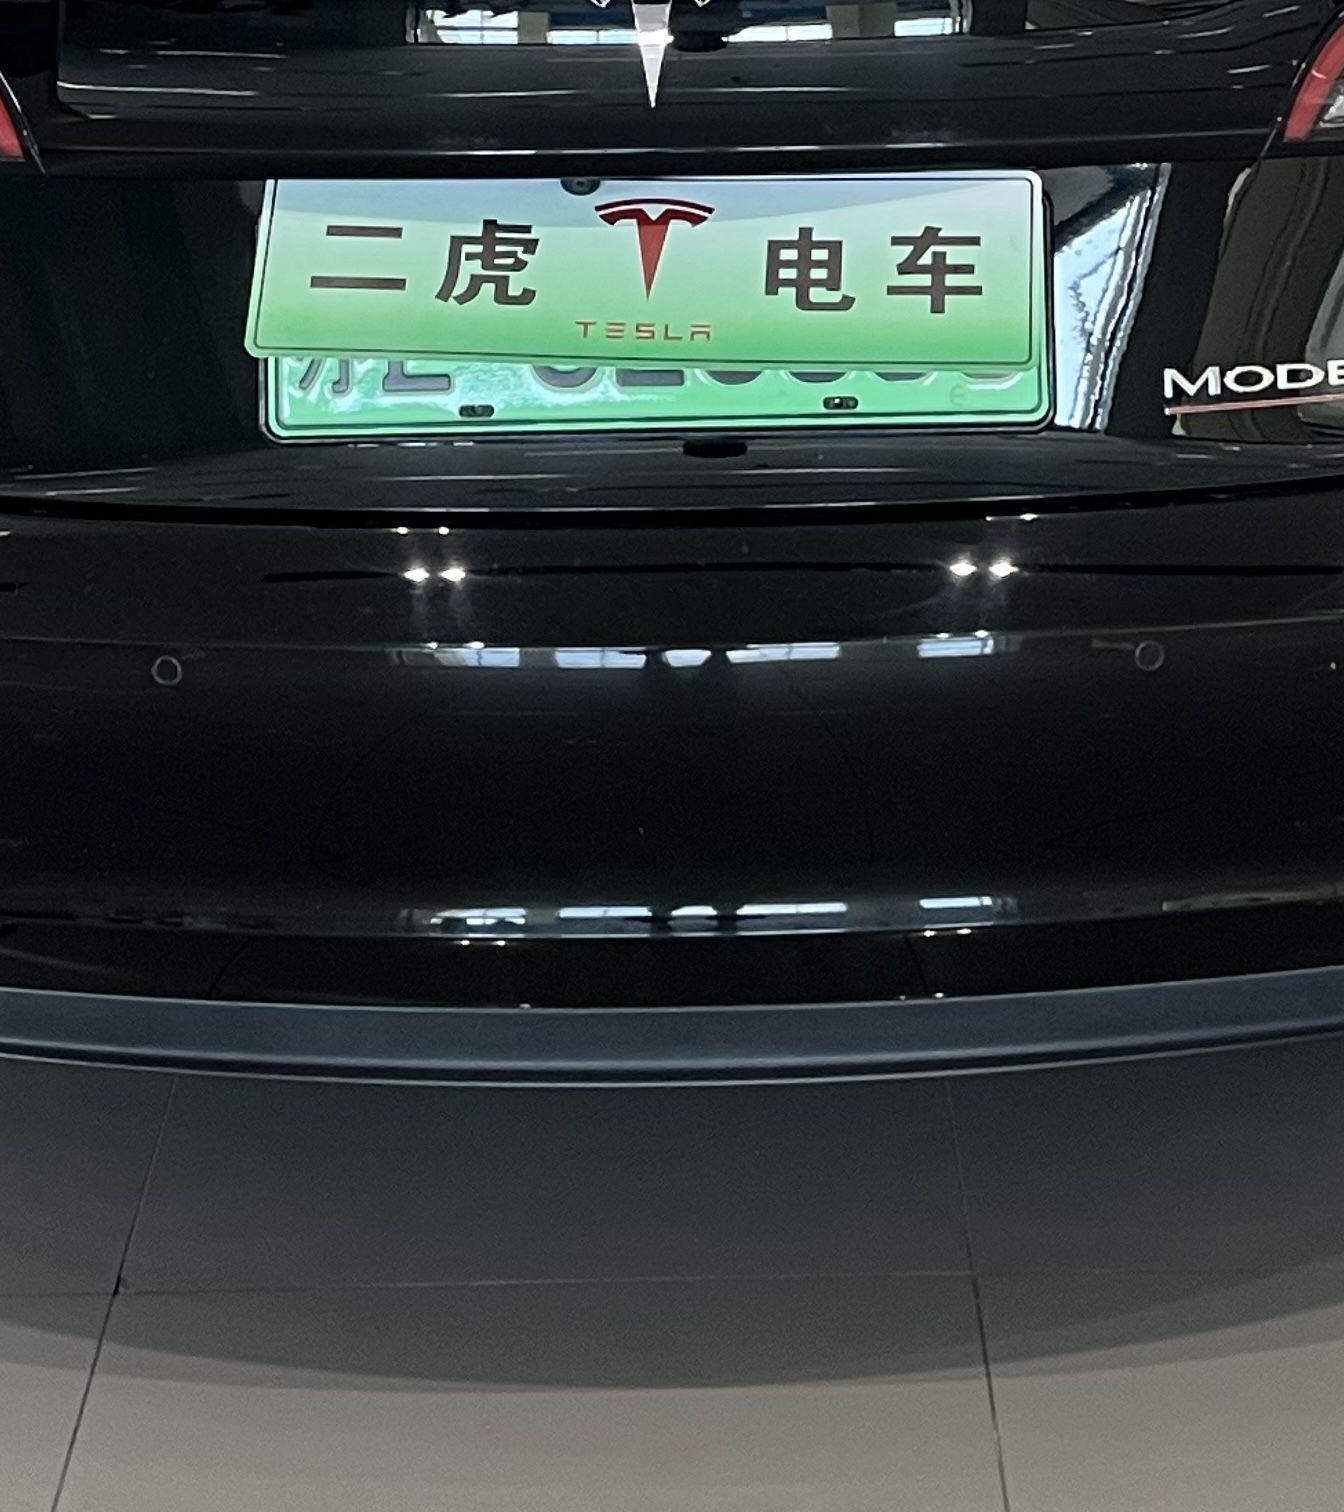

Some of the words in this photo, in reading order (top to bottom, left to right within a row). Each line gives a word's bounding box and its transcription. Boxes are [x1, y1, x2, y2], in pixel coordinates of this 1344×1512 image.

[310, 219, 541, 306] 二虎
[764, 226, 984, 314] 电车
[575, 320, 713, 342] TESLA
